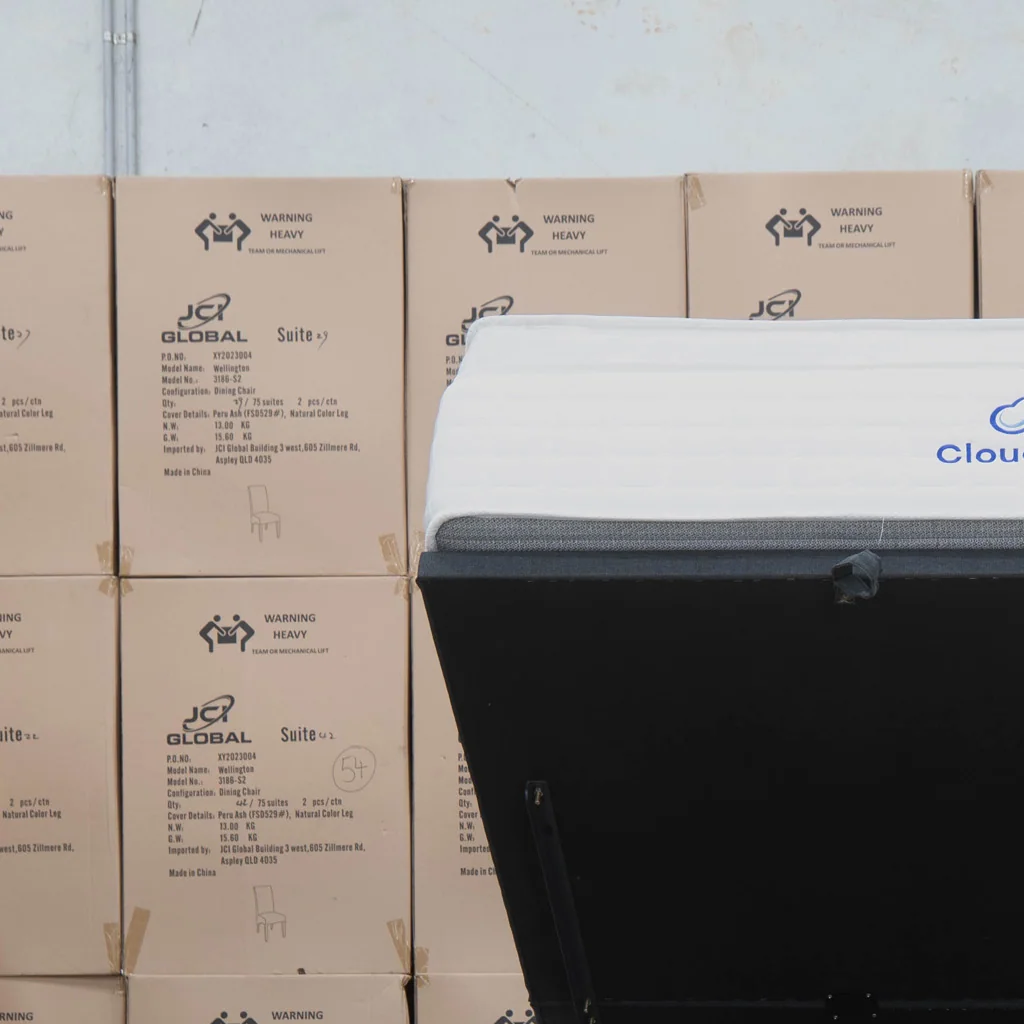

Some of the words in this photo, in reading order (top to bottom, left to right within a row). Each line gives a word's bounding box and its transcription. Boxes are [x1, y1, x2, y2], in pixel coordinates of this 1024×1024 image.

[830, 207, 883, 217] WARNING
[260, 212, 313, 223] WARNING
[543, 214, 595, 224] WARNING
[840, 224, 874, 234] HEAVY
[270, 230, 304, 240] HEAVY
[552, 231, 586, 240] HEAVY
[161, 330, 248, 344] GLOBAL
[278, 327, 313, 343] Suite
[161, 364, 182, 373] Model
[213, 364, 250, 374] Wellington
[162, 376, 183, 385] Model
[214, 386, 237, 396] Dining
[237, 386, 256, 395] Chair
[253, 398, 261, 407] 75
[262, 398, 284, 407] suites
[298, 397, 302, 406] 2
[162, 410, 182, 419] Cover
[213, 409, 229, 419] Peru
[230, 409, 243, 418] Ash
[290, 409, 316, 418] Natural
[317, 409, 335, 418] Color
[336, 409, 349, 418] Leg
[214, 421, 234, 430] 13.00
[241, 420, 250, 430] KG
[215, 432, 234, 442] 15.60
[242, 432, 252, 441] KG
[164, 445, 195, 454] Imported
[227, 443, 249, 453] Global
[250, 443, 279, 453] Building
[319, 442, 348, 452] Zillmere
[215, 455, 238, 465] Aspley
[239, 455, 253, 465] QLD
[254, 455, 272, 464] 4035
[164, 468, 183, 477] Made
[184, 468, 191, 476] in
[192, 467, 211, 476] China
[264, 614, 316, 623] WARNING
[273, 630, 307, 640] HEAVY
[167, 731, 252, 746] GLOBAL
[281, 726, 316, 743] Suite
[167, 766, 188, 775] Model
[218, 765, 254, 775] Wellington
[341, 755, 368, 783] 54
[167, 777, 188, 786] Model
[219, 787, 242, 798] Dining
[242, 787, 261, 796] Chair
[257, 798, 266, 808] 75
[267, 798, 289, 808] suites
[302, 798, 307, 807] 2
[167, 812, 187, 821] Cover
[218, 810, 234, 820] Peru
[234, 810, 247, 819] Ash
[295, 809, 321, 819] Natural
[322, 809, 340, 818] Color
[341, 808, 354, 819] Leg
[220, 822, 239, 831] 13.00
[245, 821, 256, 830] KG
[220, 833, 239, 843] 15.60
[248, 833, 258, 842] KG
[168, 846, 200, 856] Imported
[232, 844, 254, 854] Global
[255, 844, 284, 854] Building
[324, 843, 353, 852] Zillmere
[221, 856, 244, 866] Aspley
[244, 856, 259, 865] QLD
[260, 855, 278, 865] 4035
[169, 868, 188, 878] Made
[188, 868, 196, 877] in
[196, 868, 217, 877] China
[0, 1012, 34, 1022] RNING
[271, 1011, 324, 1020] WARNING
